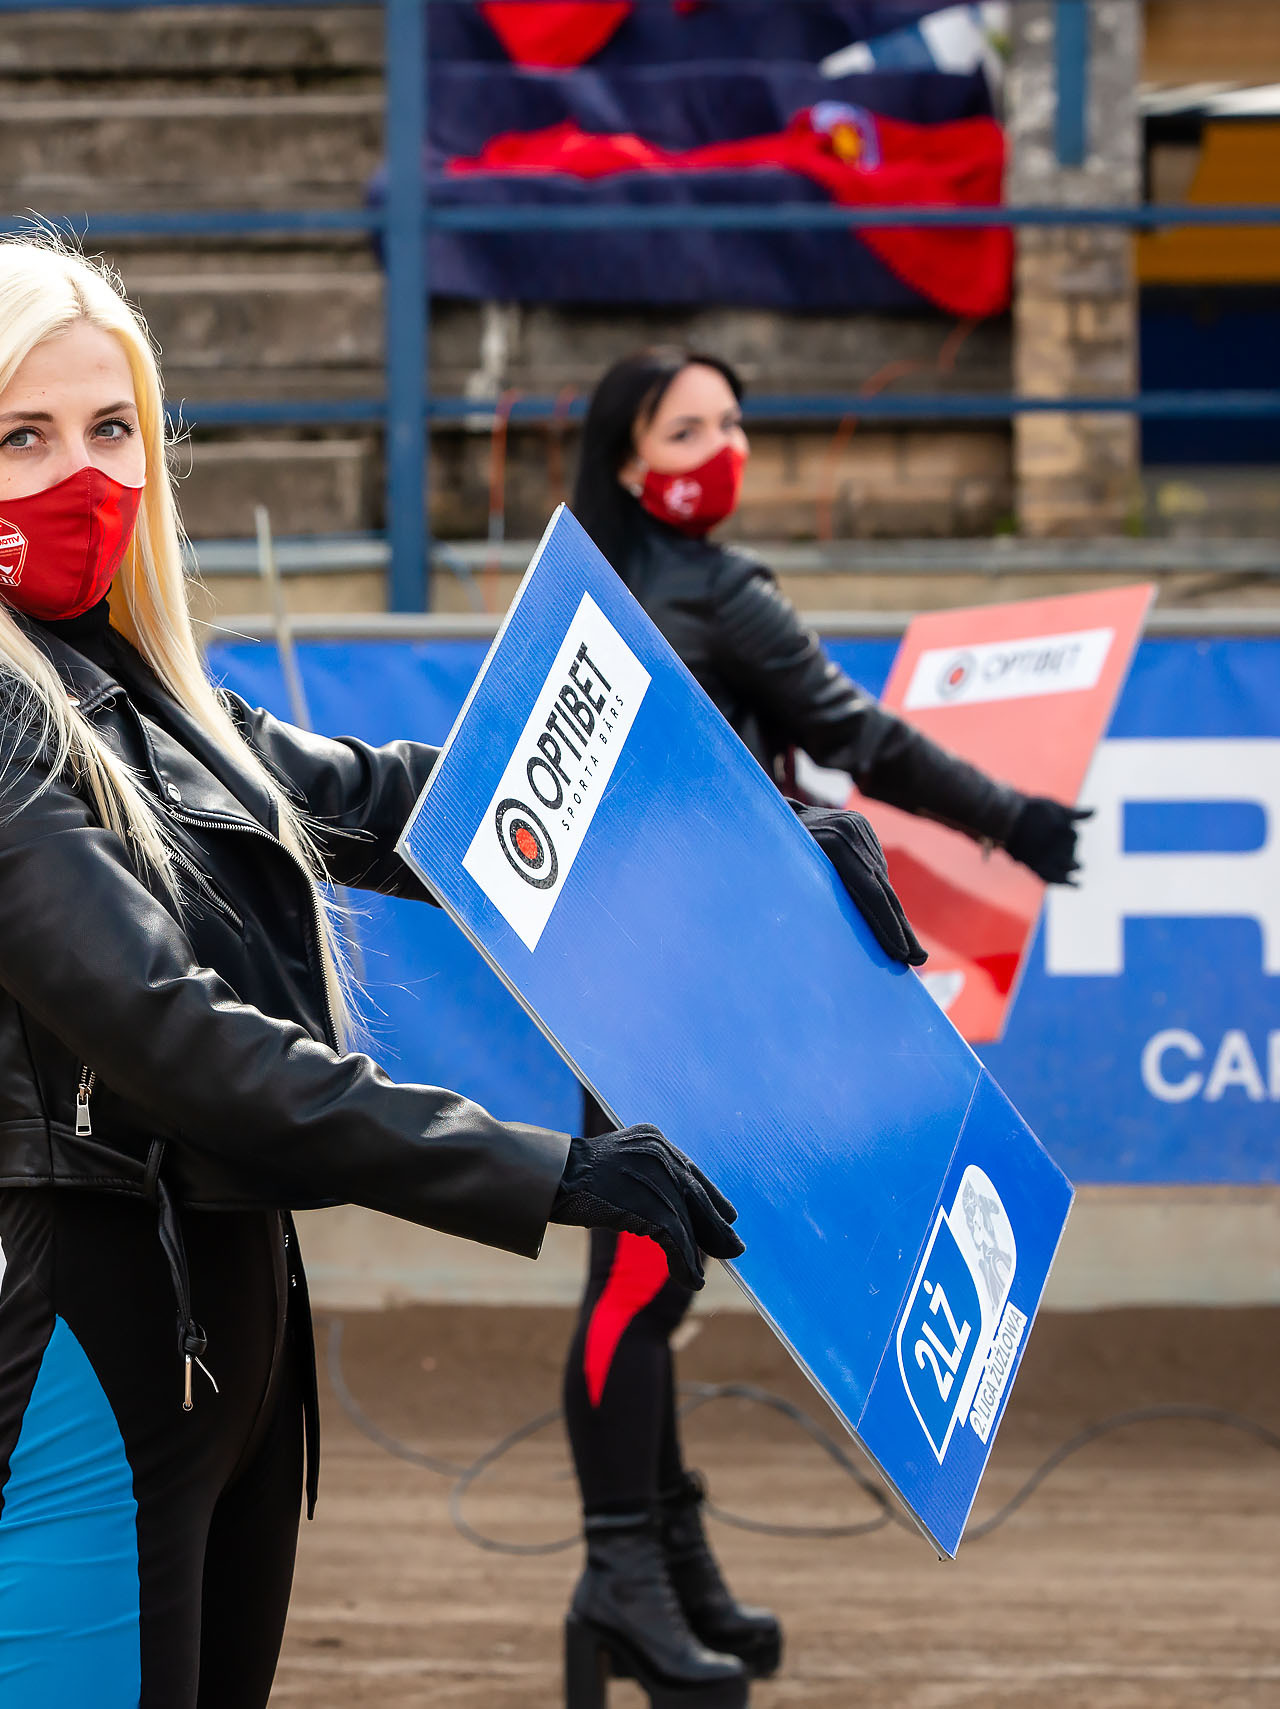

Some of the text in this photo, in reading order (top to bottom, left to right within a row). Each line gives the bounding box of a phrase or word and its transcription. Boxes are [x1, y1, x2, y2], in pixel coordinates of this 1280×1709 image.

[526, 641, 612, 810] OPTIBET
[561, 695, 624, 831] SPORTA BĀRS
[1141, 1027, 1280, 1103] CA
[914, 1279, 972, 1403] 2LŻ
[978, 1380, 999, 1421] LIGA
